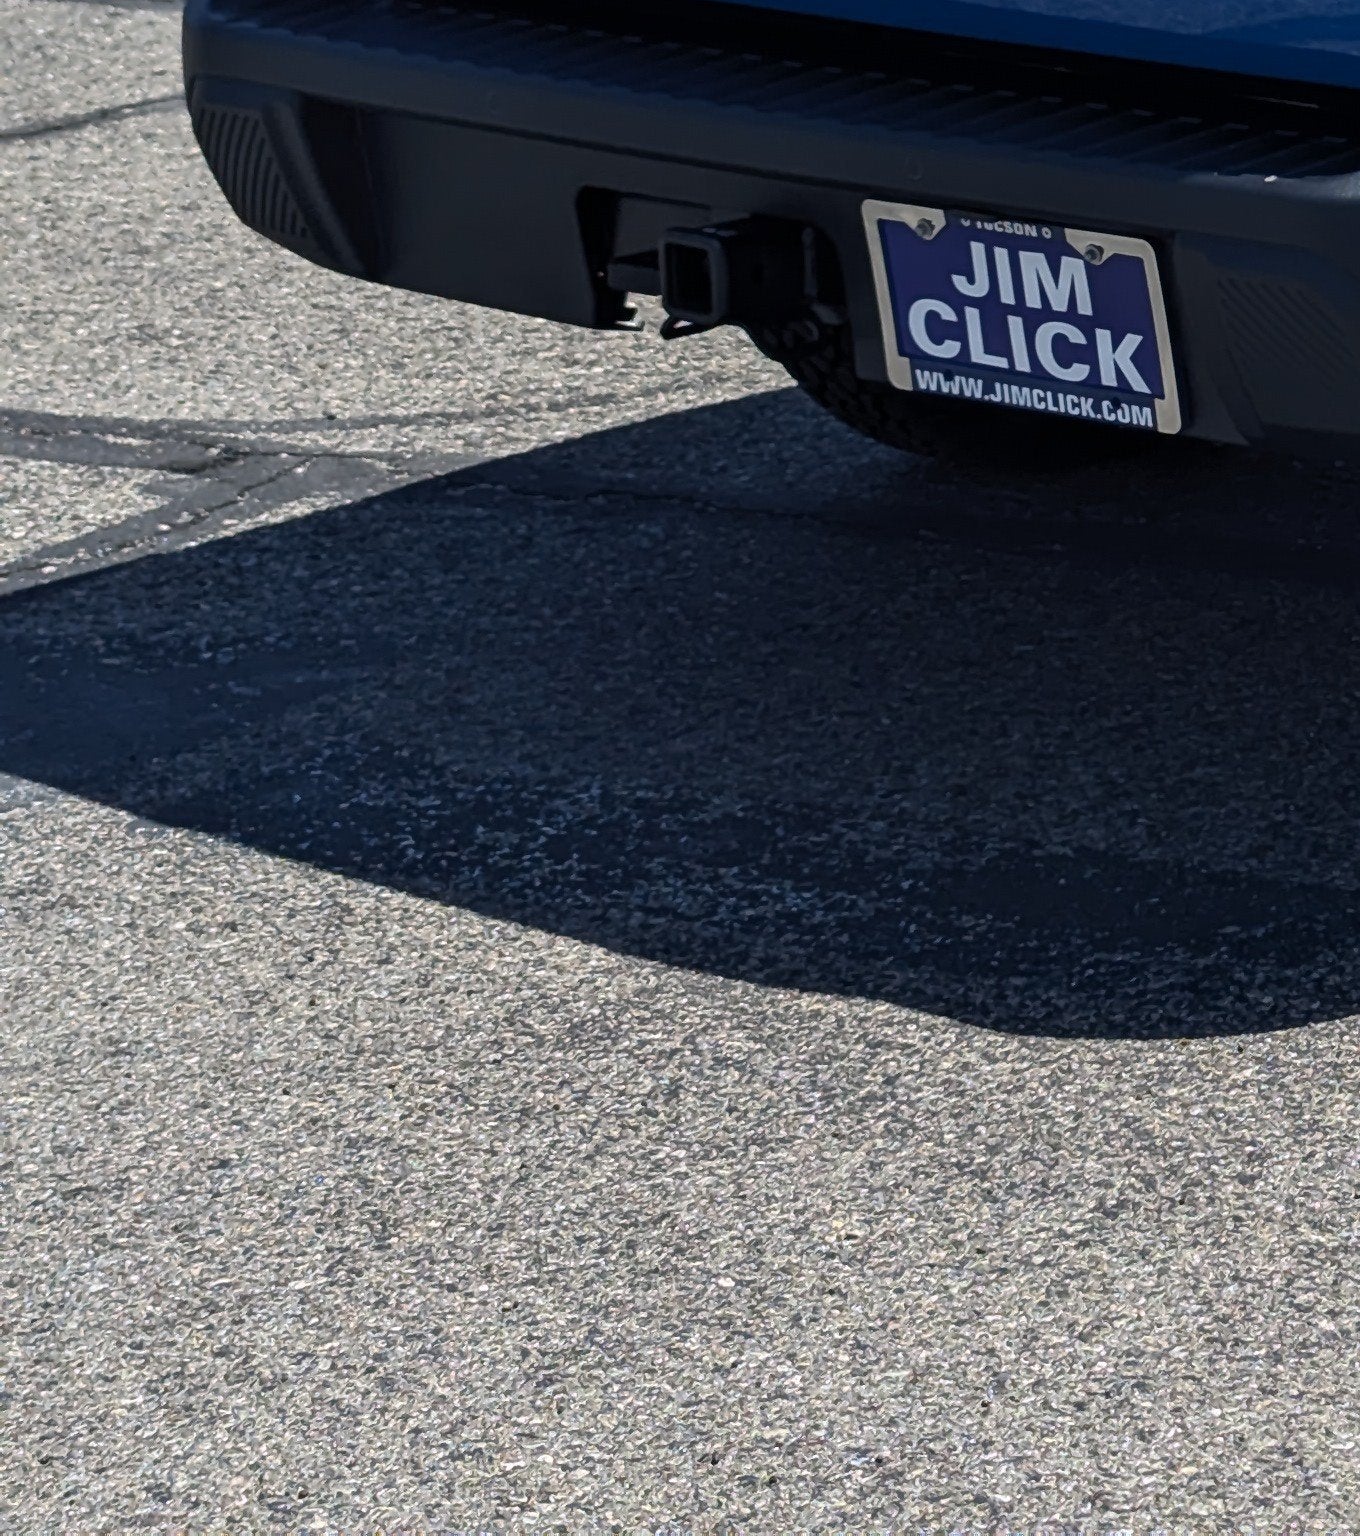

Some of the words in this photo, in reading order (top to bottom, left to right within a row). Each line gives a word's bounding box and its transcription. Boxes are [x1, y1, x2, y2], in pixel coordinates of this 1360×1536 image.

[951, 240, 1094, 316] JIM
[907, 298, 1153, 395] CLICK
[914, 368, 1154, 428] WWW.JIMCLICK.COM
